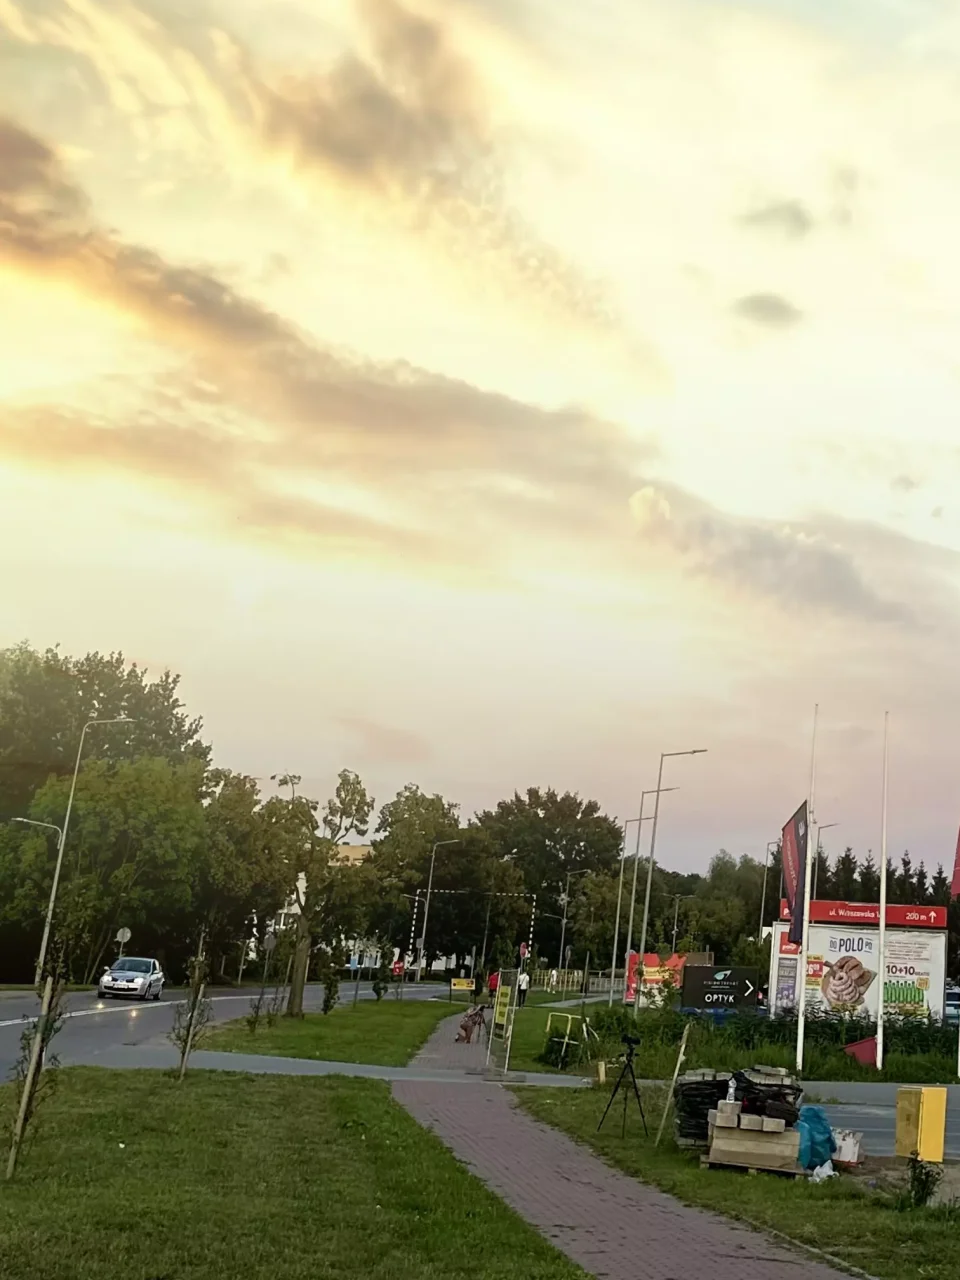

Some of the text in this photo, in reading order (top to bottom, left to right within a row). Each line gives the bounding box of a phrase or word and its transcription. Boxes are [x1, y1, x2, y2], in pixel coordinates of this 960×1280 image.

[905, 912, 919, 921] 200
[838, 937, 864, 952] POLO
[886, 965, 915, 975] 10+10
[704, 993, 735, 1003] OPTYK
